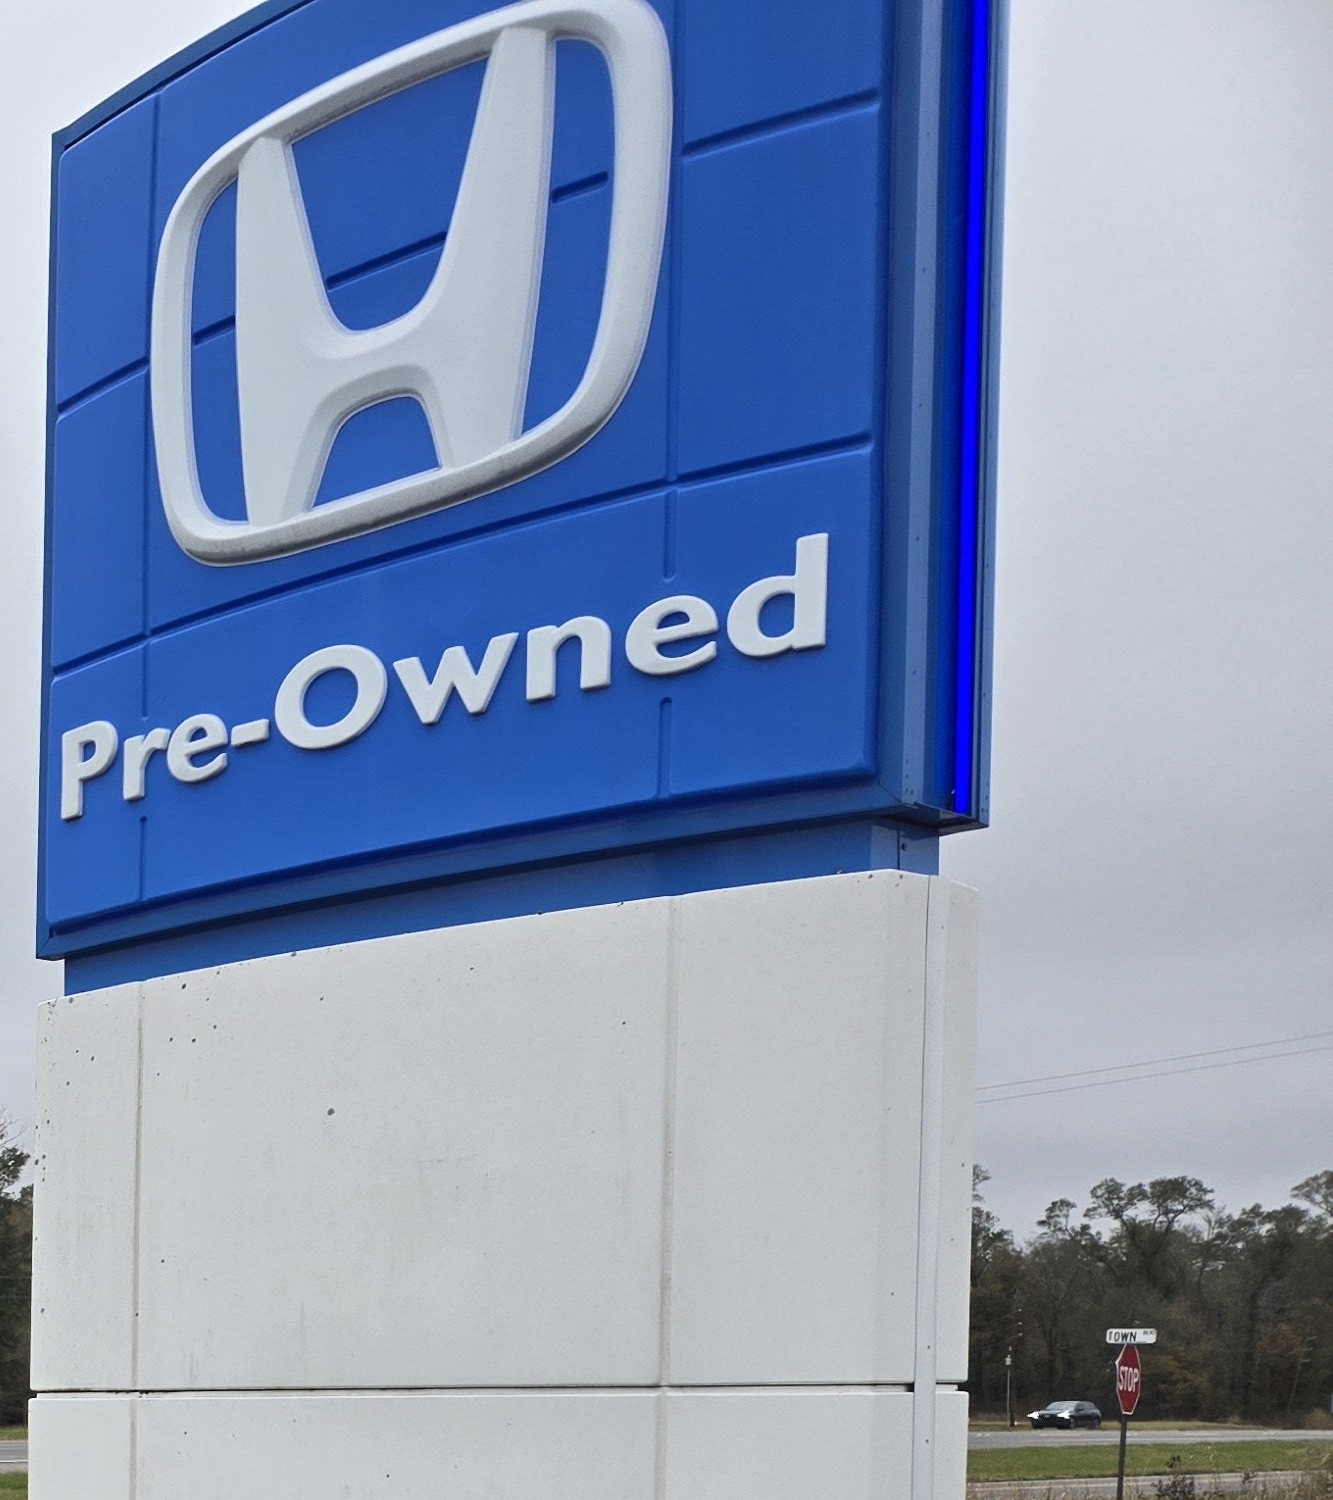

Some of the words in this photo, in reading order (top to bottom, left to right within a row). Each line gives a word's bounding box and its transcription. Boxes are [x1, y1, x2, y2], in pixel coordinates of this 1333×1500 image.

[60, 532, 830, 822] Pre-Owned
[1108, 1331, 1137, 1342] TOWN
[1118, 1365, 1139, 1392] STOP
